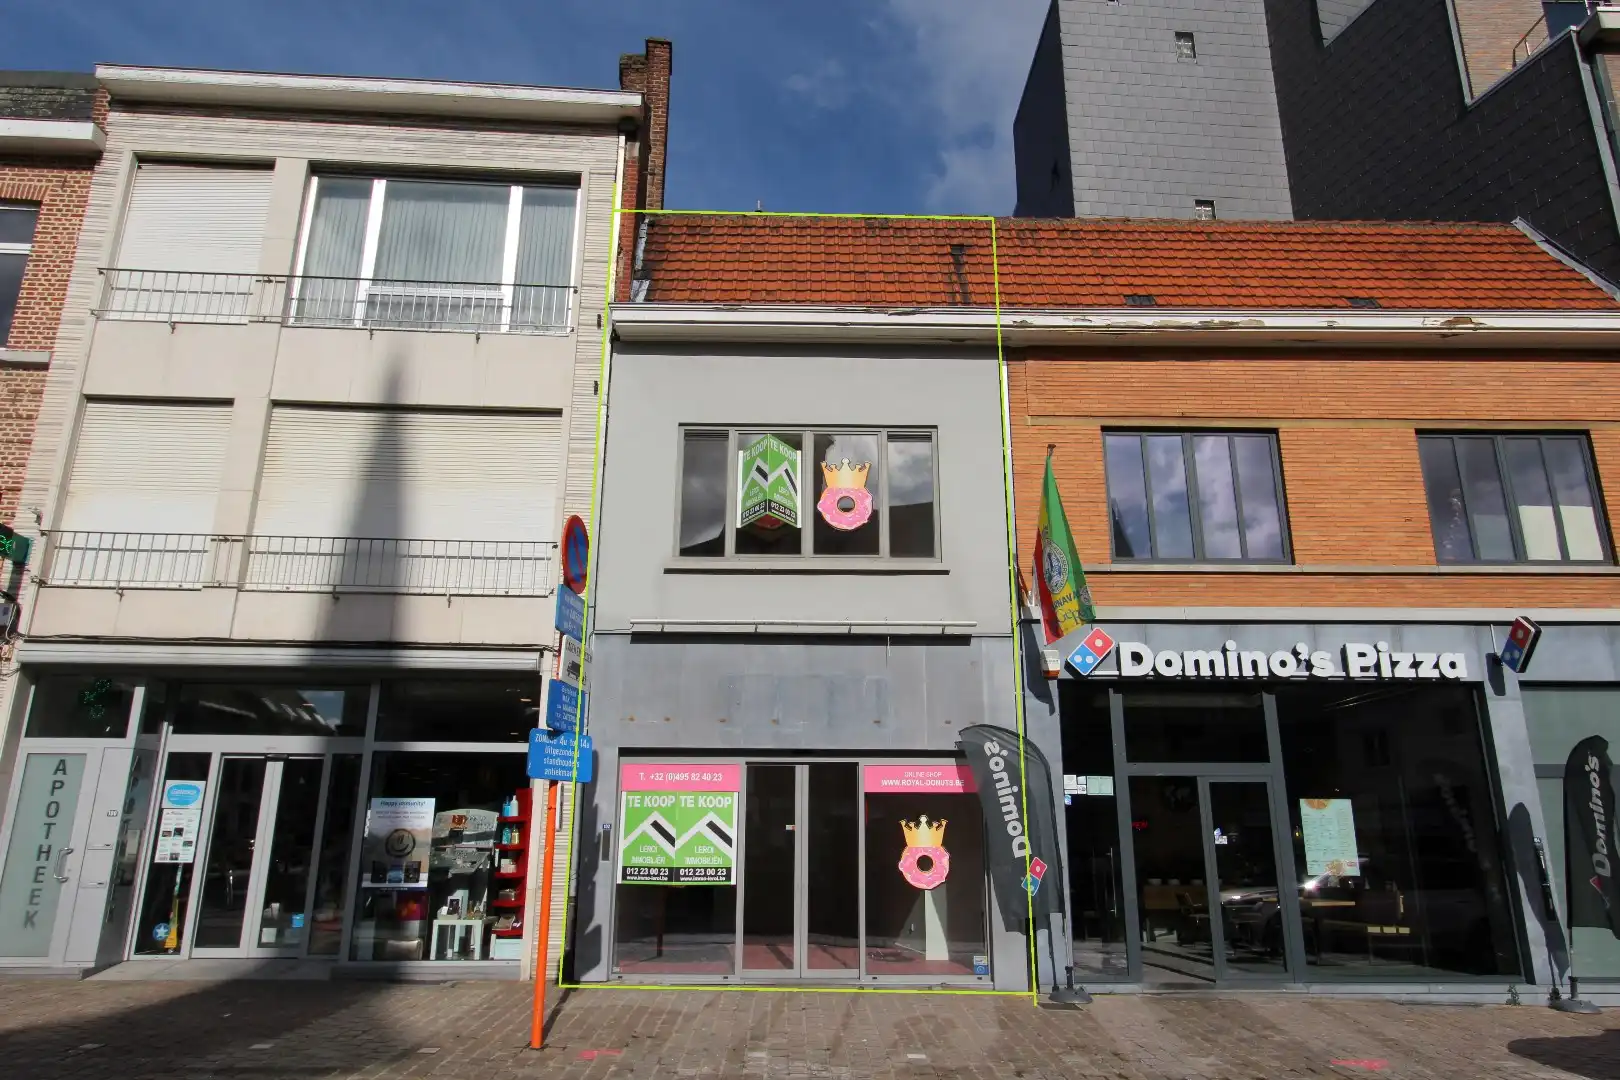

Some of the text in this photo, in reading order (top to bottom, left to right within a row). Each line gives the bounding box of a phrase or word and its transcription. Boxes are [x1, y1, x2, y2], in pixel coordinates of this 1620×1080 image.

[752, 439, 768, 458] KOOP
[770, 438, 796, 462] TE KOOP
[1118, 640, 1467, 679] Domino's Pizza
[544, 757, 580, 768] standhoudes
[650, 772, 664, 781] +32
[666, 772, 689, 782] (0)495
[691, 772, 700, 781] 82
[702, 772, 712, 782] 40
[712, 772, 722, 782] 23
[627, 796, 676, 808] TE KOOP
[680, 796, 732, 808] TE KOOP
[1585, 751, 1611, 878] Domino's
[23, 758, 68, 930] APOTHEEK
